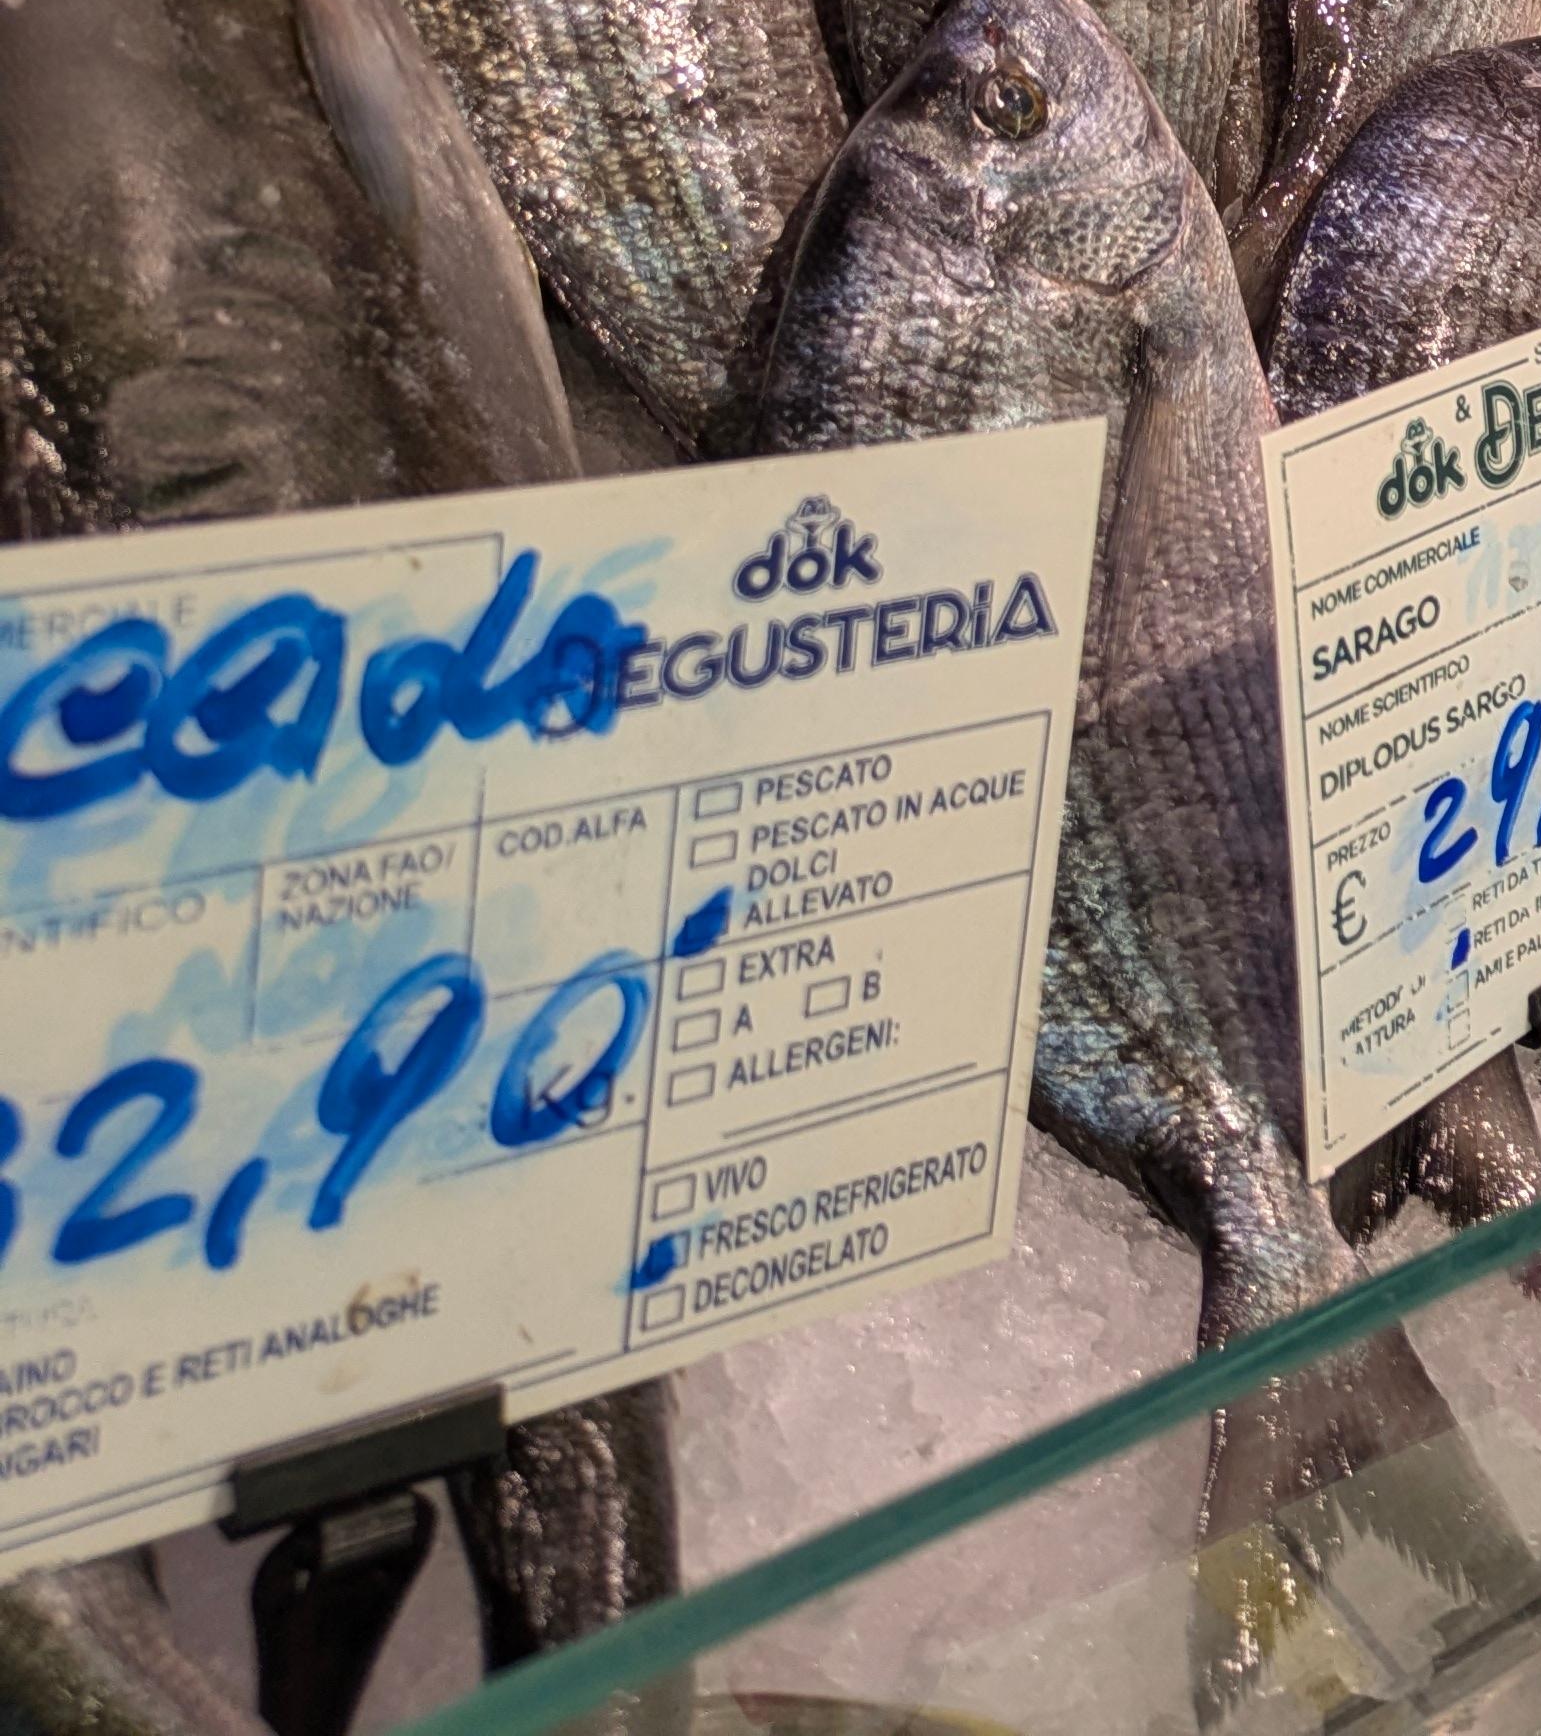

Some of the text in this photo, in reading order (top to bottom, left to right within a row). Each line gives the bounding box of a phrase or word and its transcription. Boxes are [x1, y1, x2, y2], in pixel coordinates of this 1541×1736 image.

[1376, 442, 1465, 520] dok
[1454, 397, 1472, 423] &
[733, 517, 881, 603] dok
[1312, 595, 1442, 682] SARAGO
[1320, 674, 1527, 802] DIPLODUS SARGO
[749, 768, 1027, 857] PESCATO IN ACQUE
[754, 754, 892, 806] PESCATO
[746, 851, 838, 892] DOLCI
[1326, 821, 1392, 870] PREZZO
[742, 871, 893, 929] ALLEVATO
[1331, 868, 1368, 948] €
[738, 937, 835, 984] EXTRA
[726, 1021, 901, 1092] ALLERGENI:
[698, 1141, 988, 1260] FRESCO REFRIGERATO
[703, 1158, 767, 1199] VIVO
[692, 1226, 888, 1314] DECONGELATO
